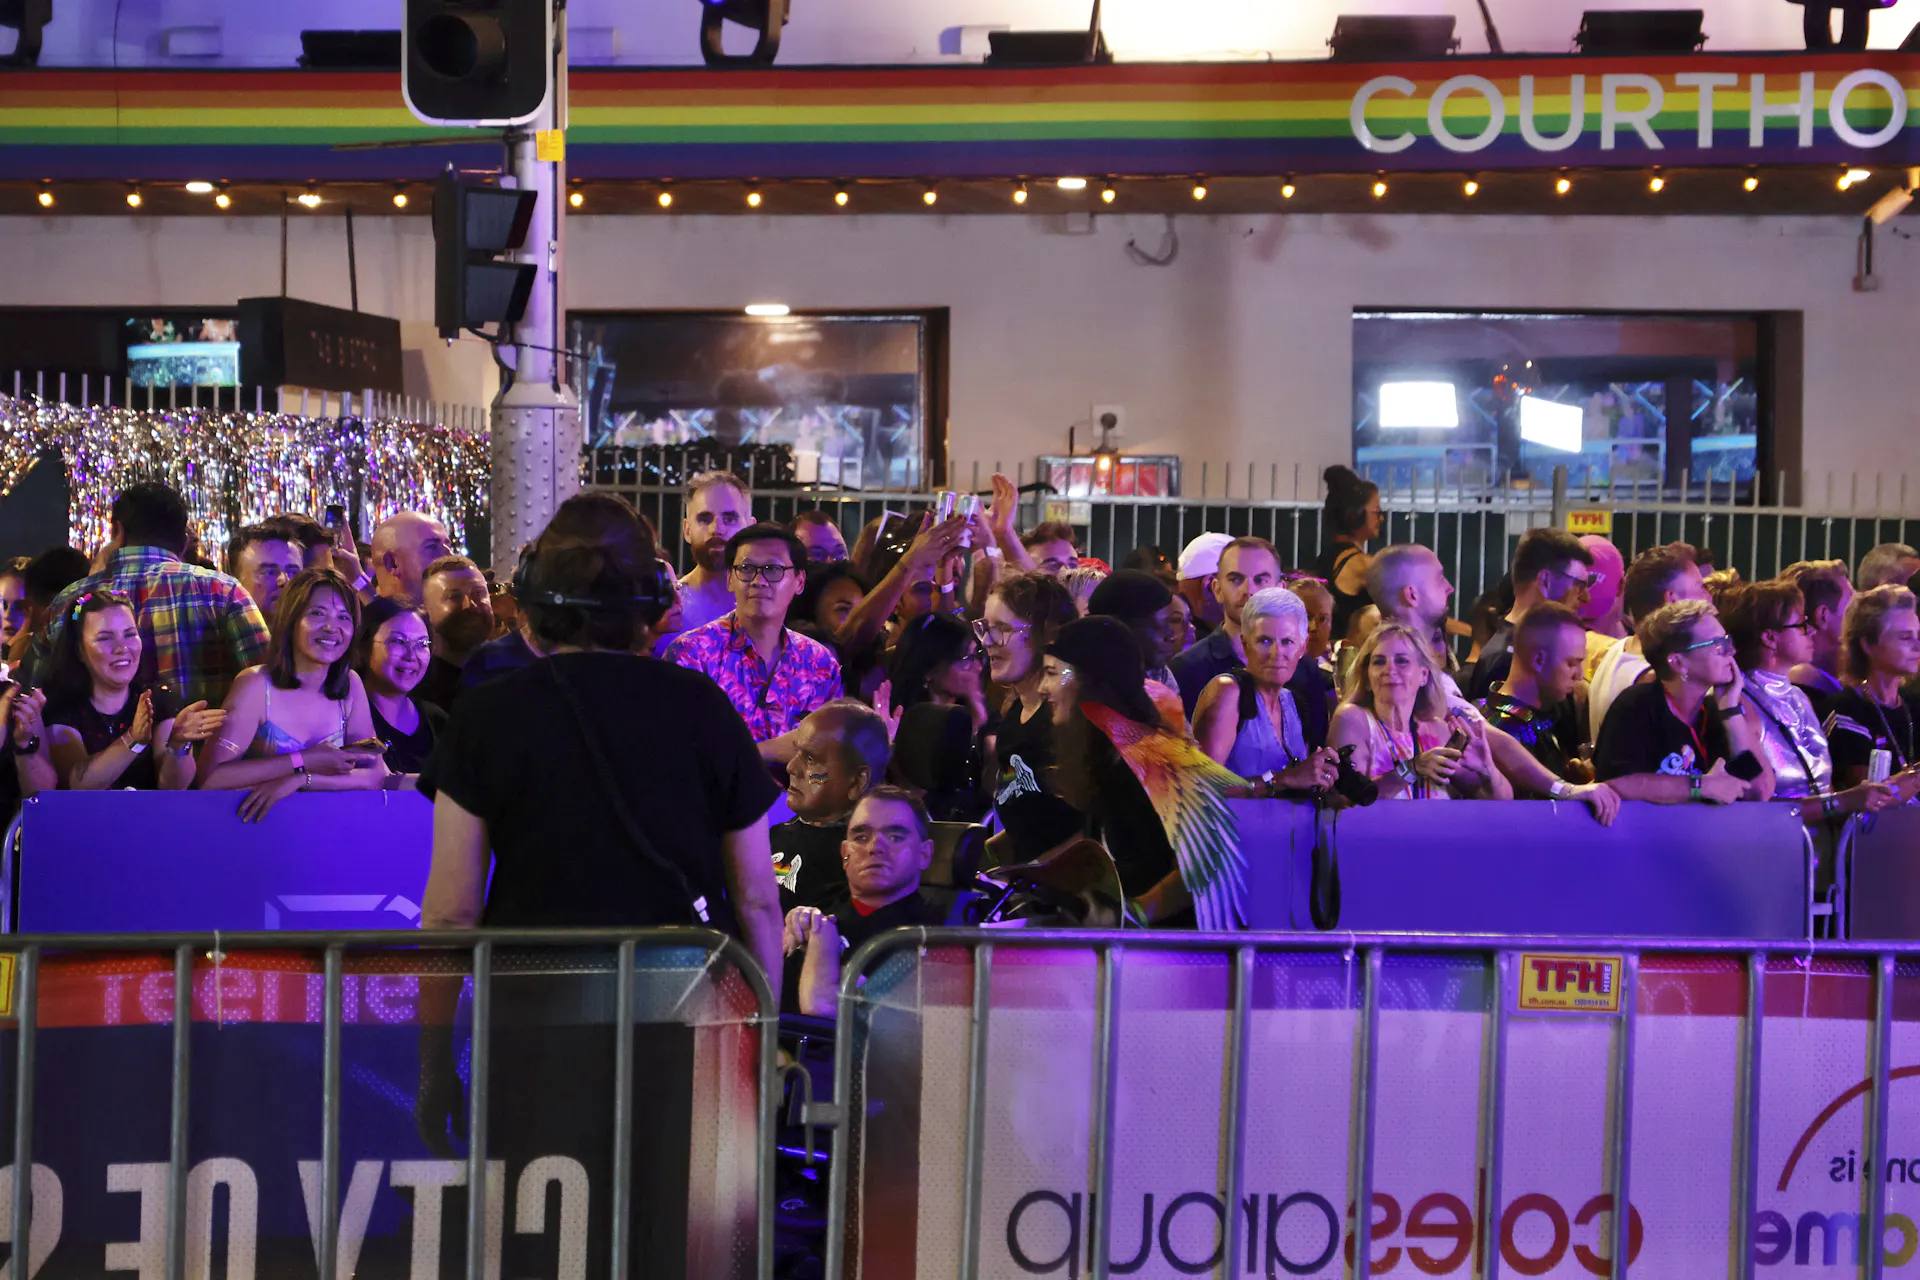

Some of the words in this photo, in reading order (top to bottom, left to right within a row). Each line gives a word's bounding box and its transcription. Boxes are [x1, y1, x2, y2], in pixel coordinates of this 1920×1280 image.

[1349, 68, 1908, 154] COURTHO
[1531, 959, 1605, 994] TFH
[1602, 963, 1612, 993] HIRE
